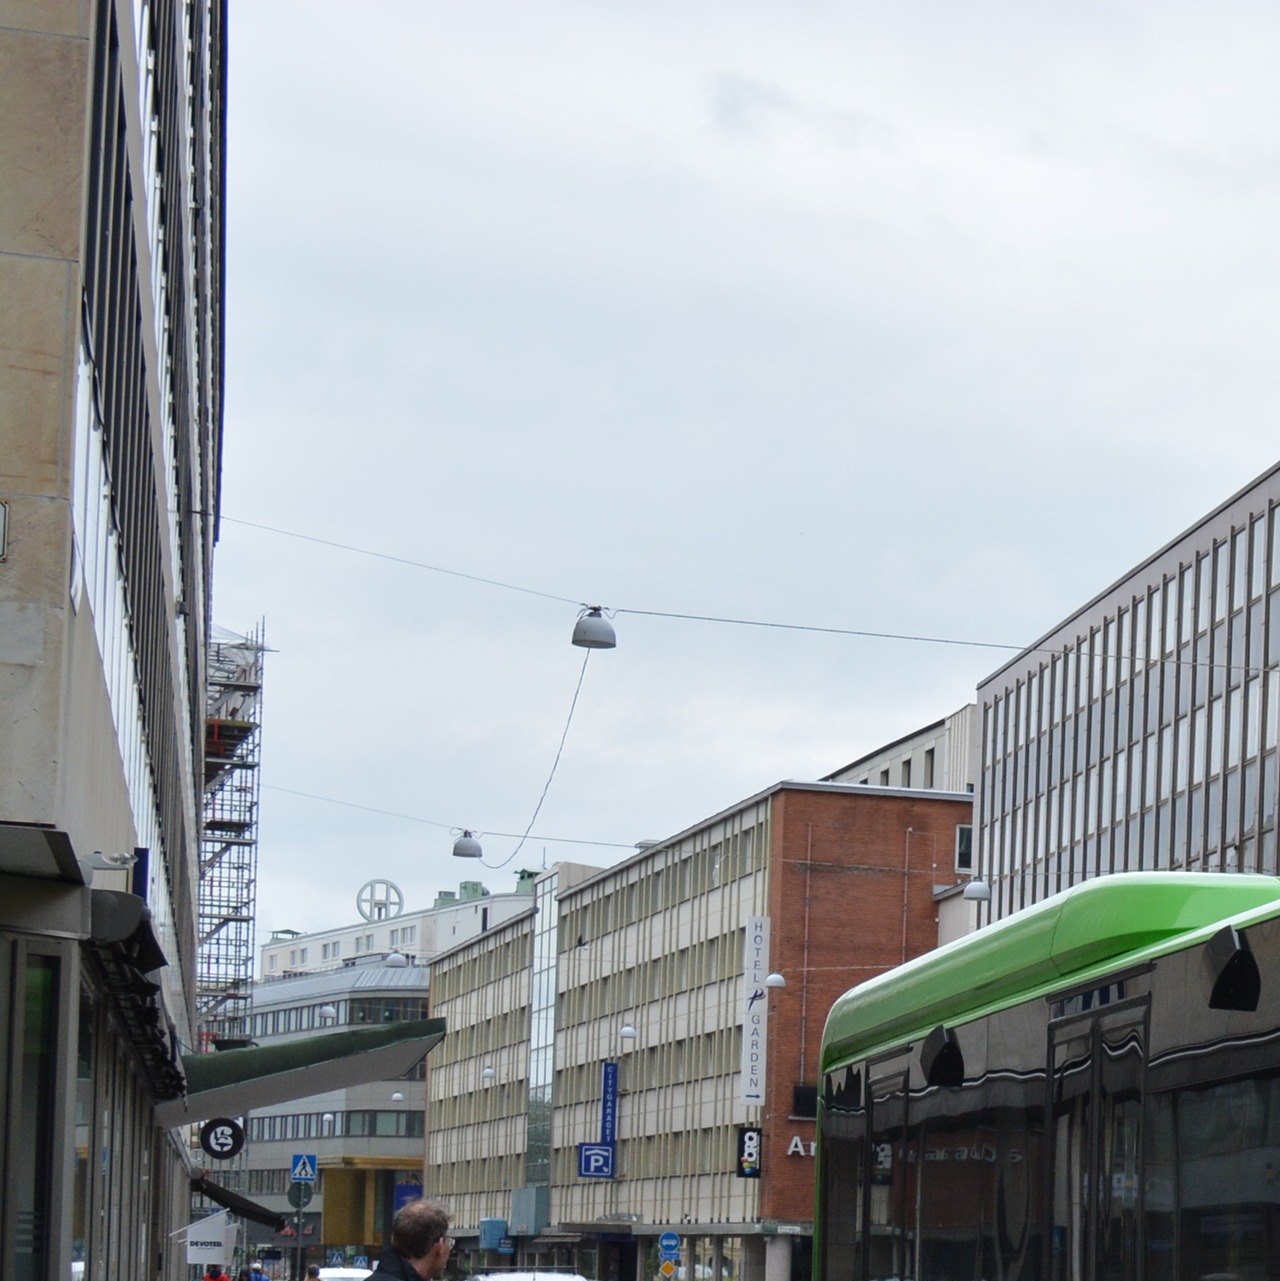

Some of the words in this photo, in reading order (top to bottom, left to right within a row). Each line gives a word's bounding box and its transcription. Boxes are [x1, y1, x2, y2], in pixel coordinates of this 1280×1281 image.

[753, 921, 763, 983] HOTEL
[750, 1015, 761, 1088] GARDEN
[605, 1066, 614, 1142] CITYGARAGET
